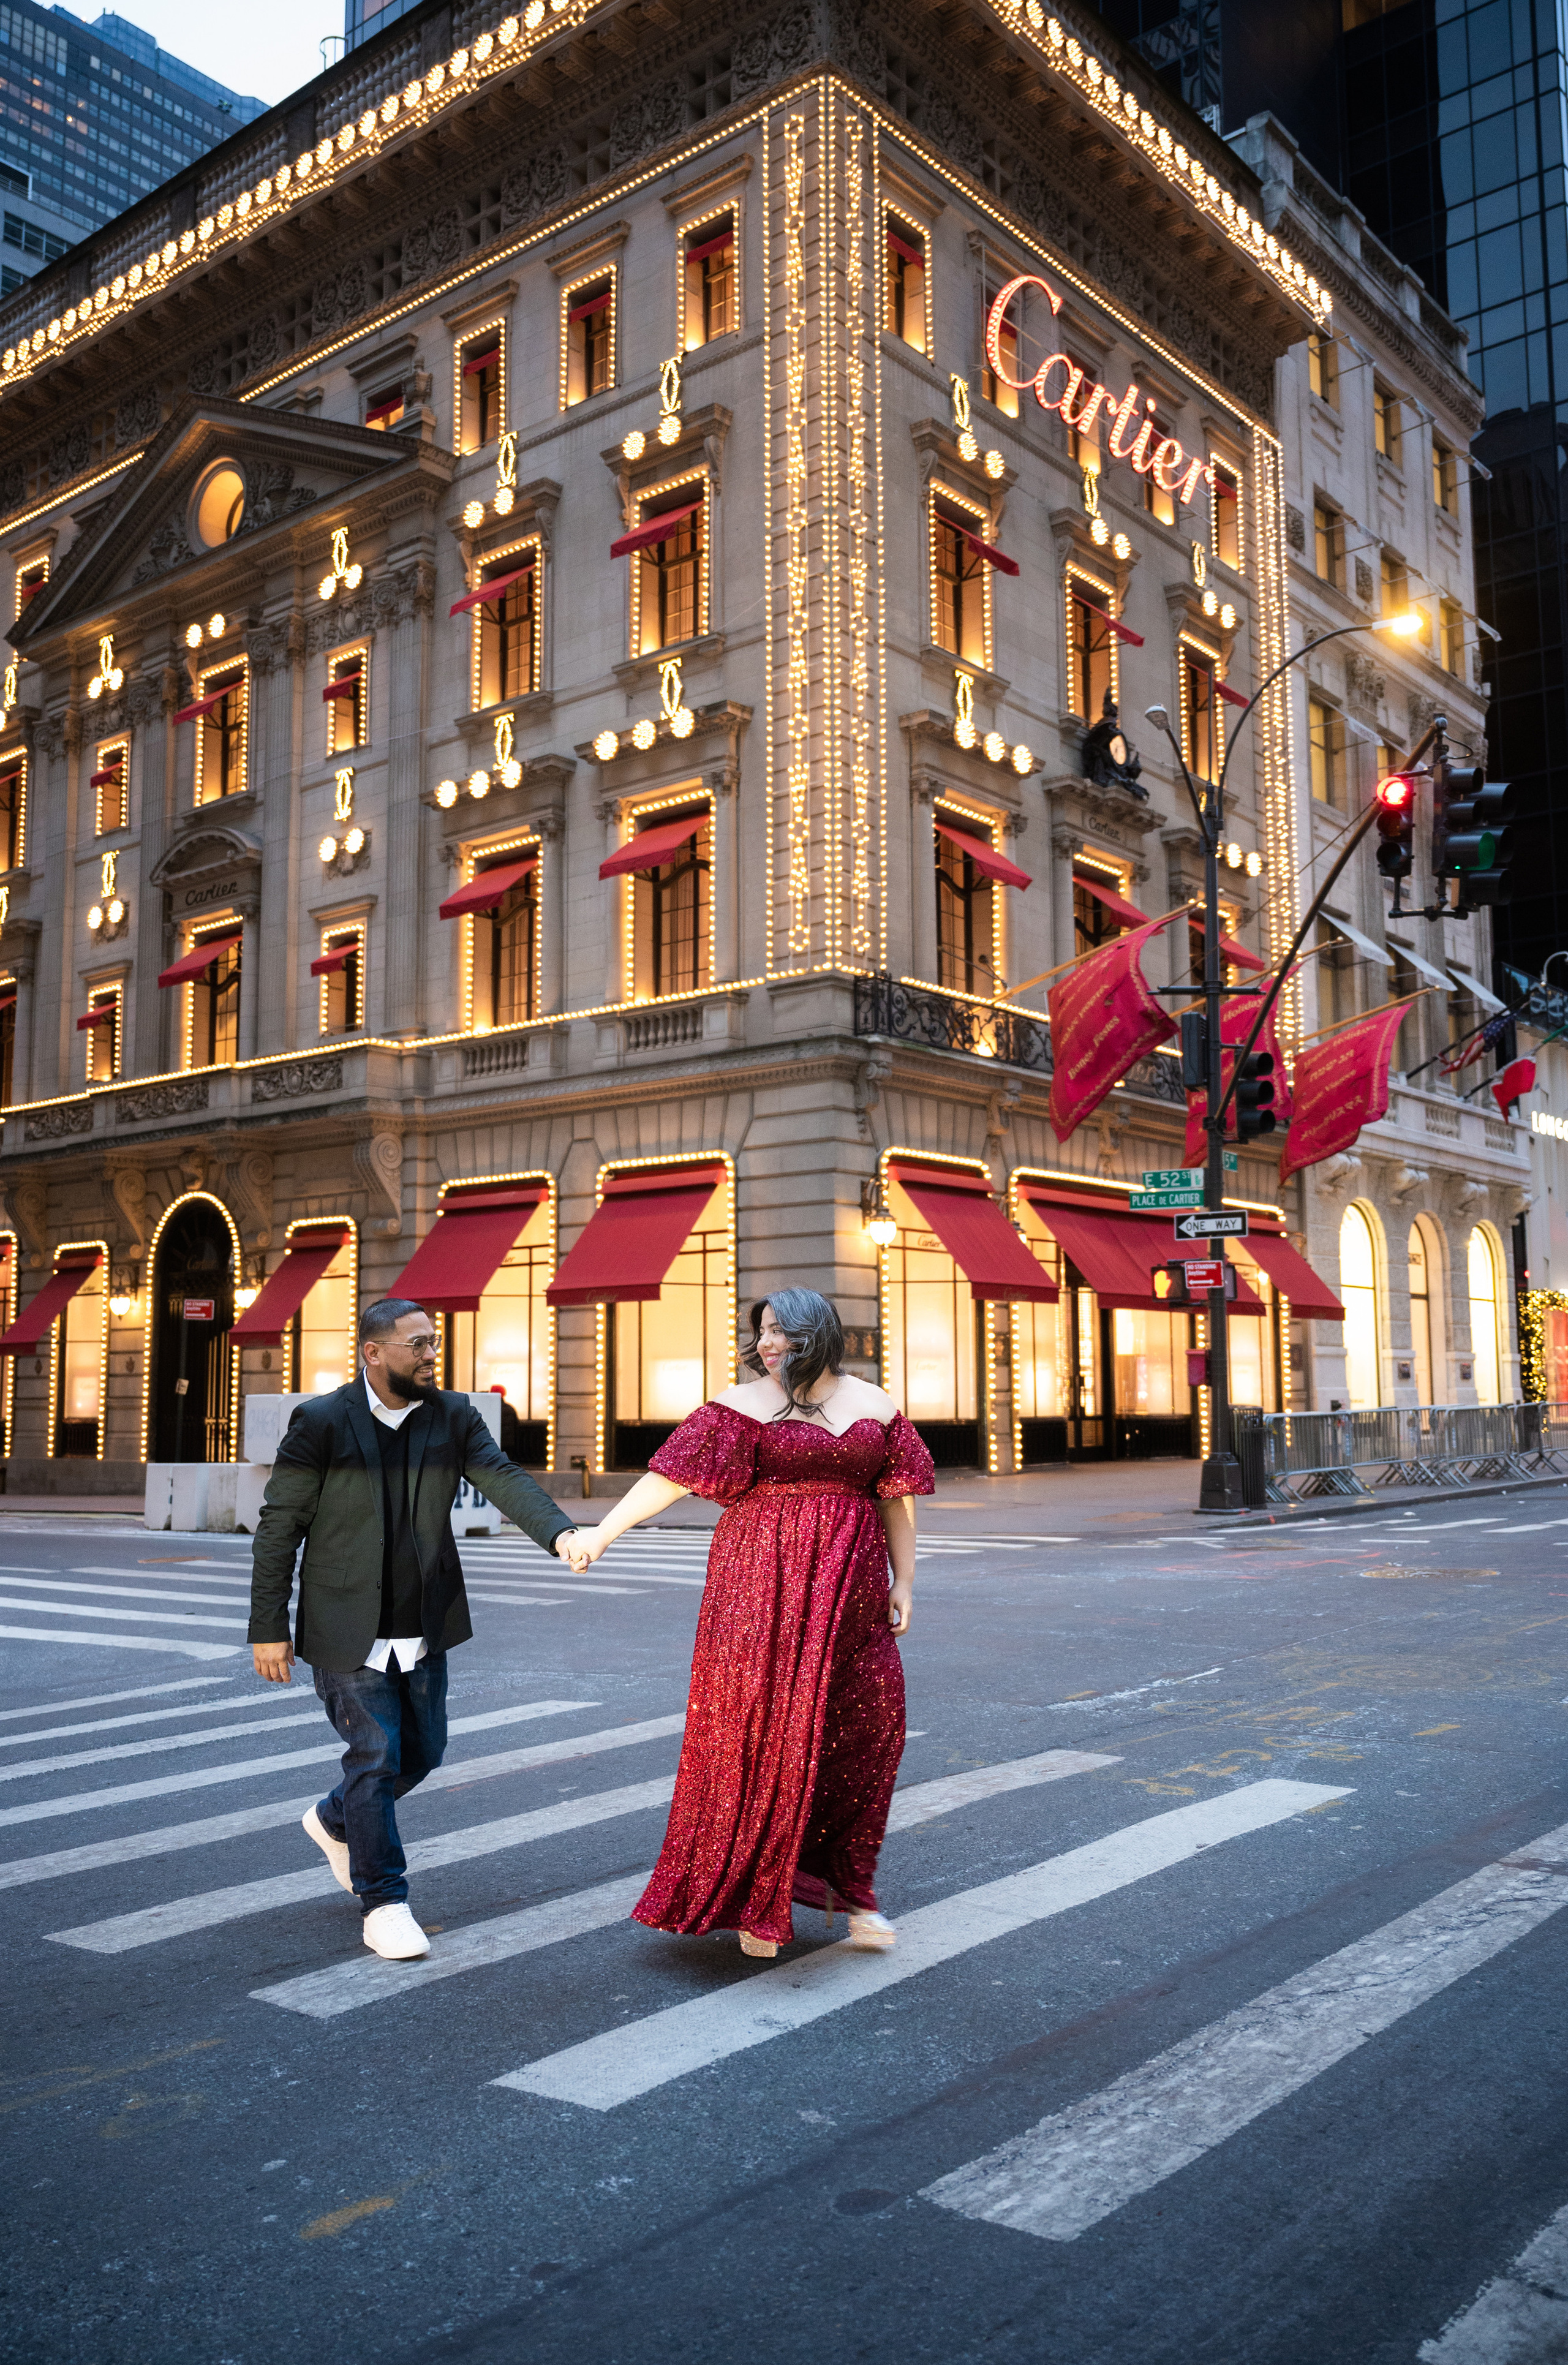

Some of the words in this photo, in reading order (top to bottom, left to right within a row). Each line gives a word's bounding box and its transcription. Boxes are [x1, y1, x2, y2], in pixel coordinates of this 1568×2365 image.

[987, 276, 1215, 504] Cartier
[1090, 817, 1120, 840] Cartier
[186, 882, 238, 906] Cartier
[1223, 997, 1264, 1022] Holiday
[1145, 1174, 1155, 1188] E
[1160, 1172, 1181, 1187] 52
[1182, 1171, 1191, 1179] ST
[1132, 1194, 1156, 1206] PLACE
[1159, 1196, 1167, 1205] DE
[1169, 1193, 1200, 1205] CARTIER
[1186, 1221, 1205, 1231] ONE
[1215, 1219, 1237, 1229] WAY
